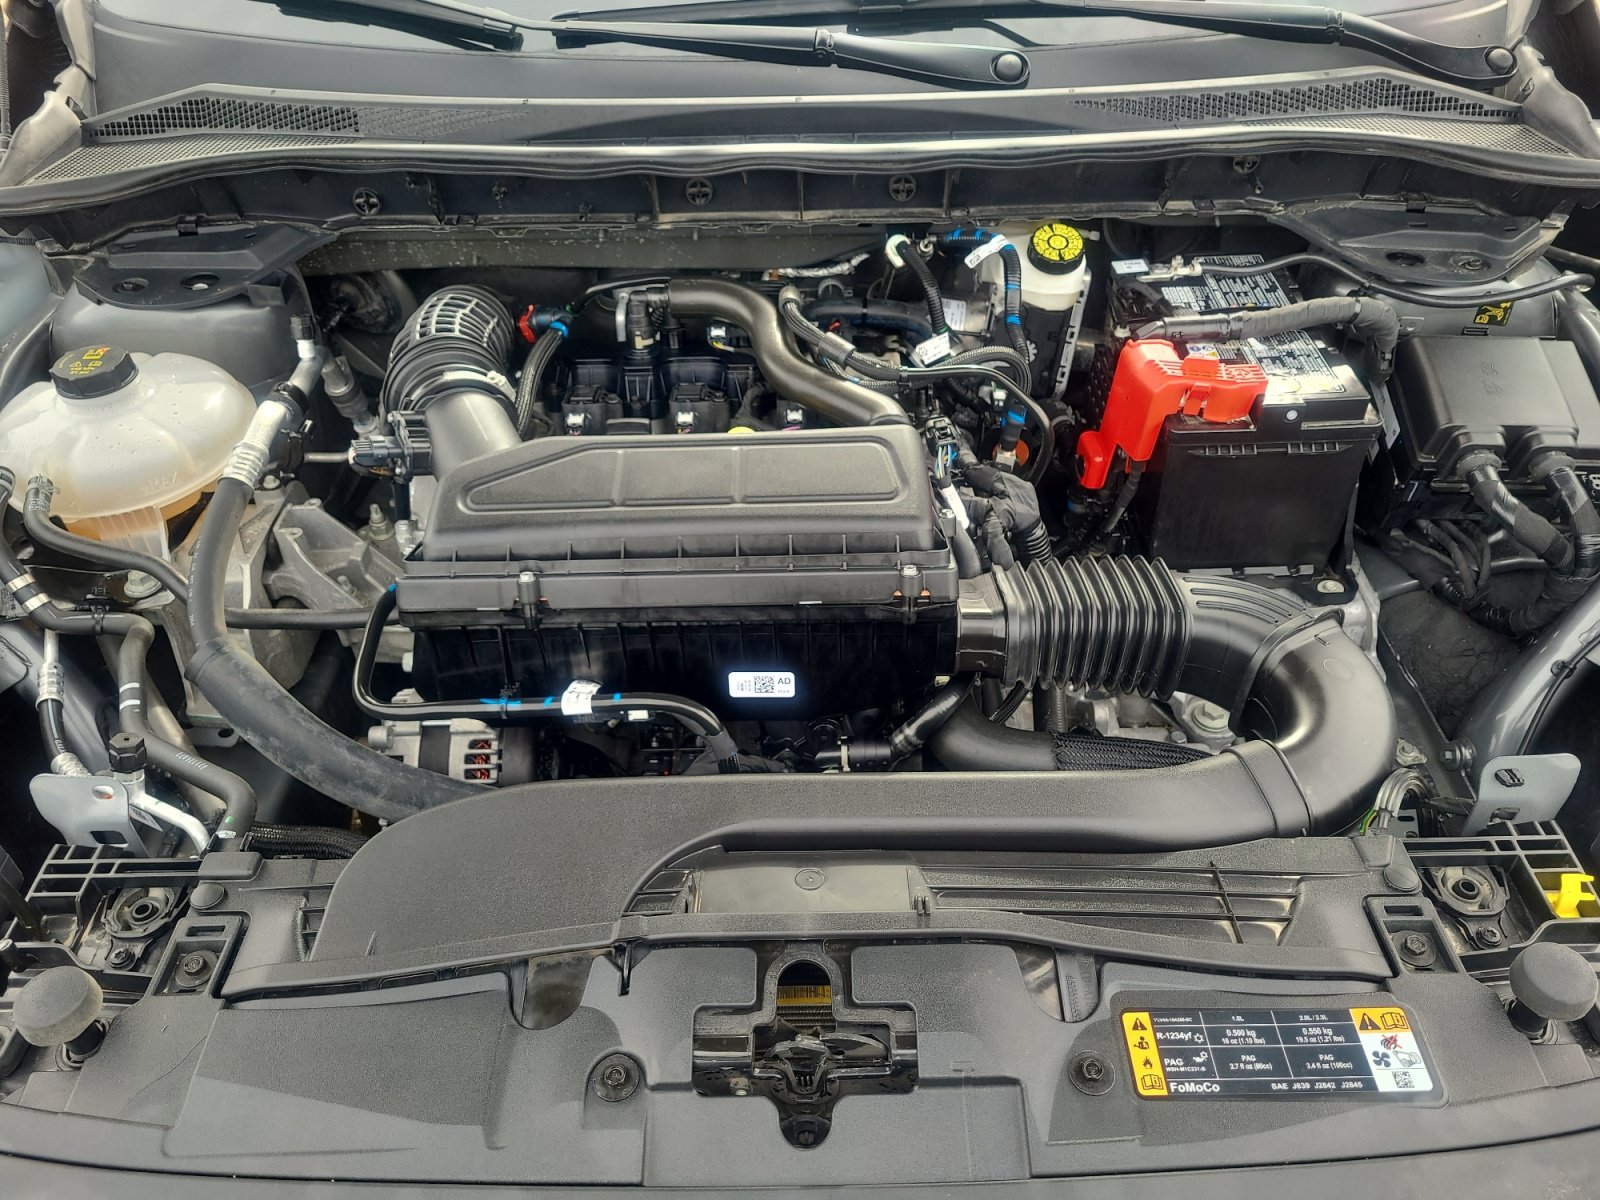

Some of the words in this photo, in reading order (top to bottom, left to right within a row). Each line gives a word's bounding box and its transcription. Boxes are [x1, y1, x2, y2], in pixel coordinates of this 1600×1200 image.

[777, 677, 791, 685] AD
[1226, 1029, 1246, 1037] 0.500
[1246, 1028, 1257, 1038] kg
[1302, 1027, 1322, 1035] 0.550
[1322, 1026, 1333, 1036] kg
[1156, 1031, 1192, 1042] R-1234yf
[1238, 1037, 1253, 1045] (1.10
[1241, 1054, 1257, 1062] PAG
[1318, 1053, 1335, 1061] PAG
[1163, 1058, 1184, 1066] PAG
[1169, 1081, 1221, 1093] FoMoCo
[1271, 1082, 1289, 1090] SAE
[1292, 1082, 1311, 1090] J639
[1314, 1081, 1337, 1089] J2842
[1341, 1081, 1364, 1089] J2845
